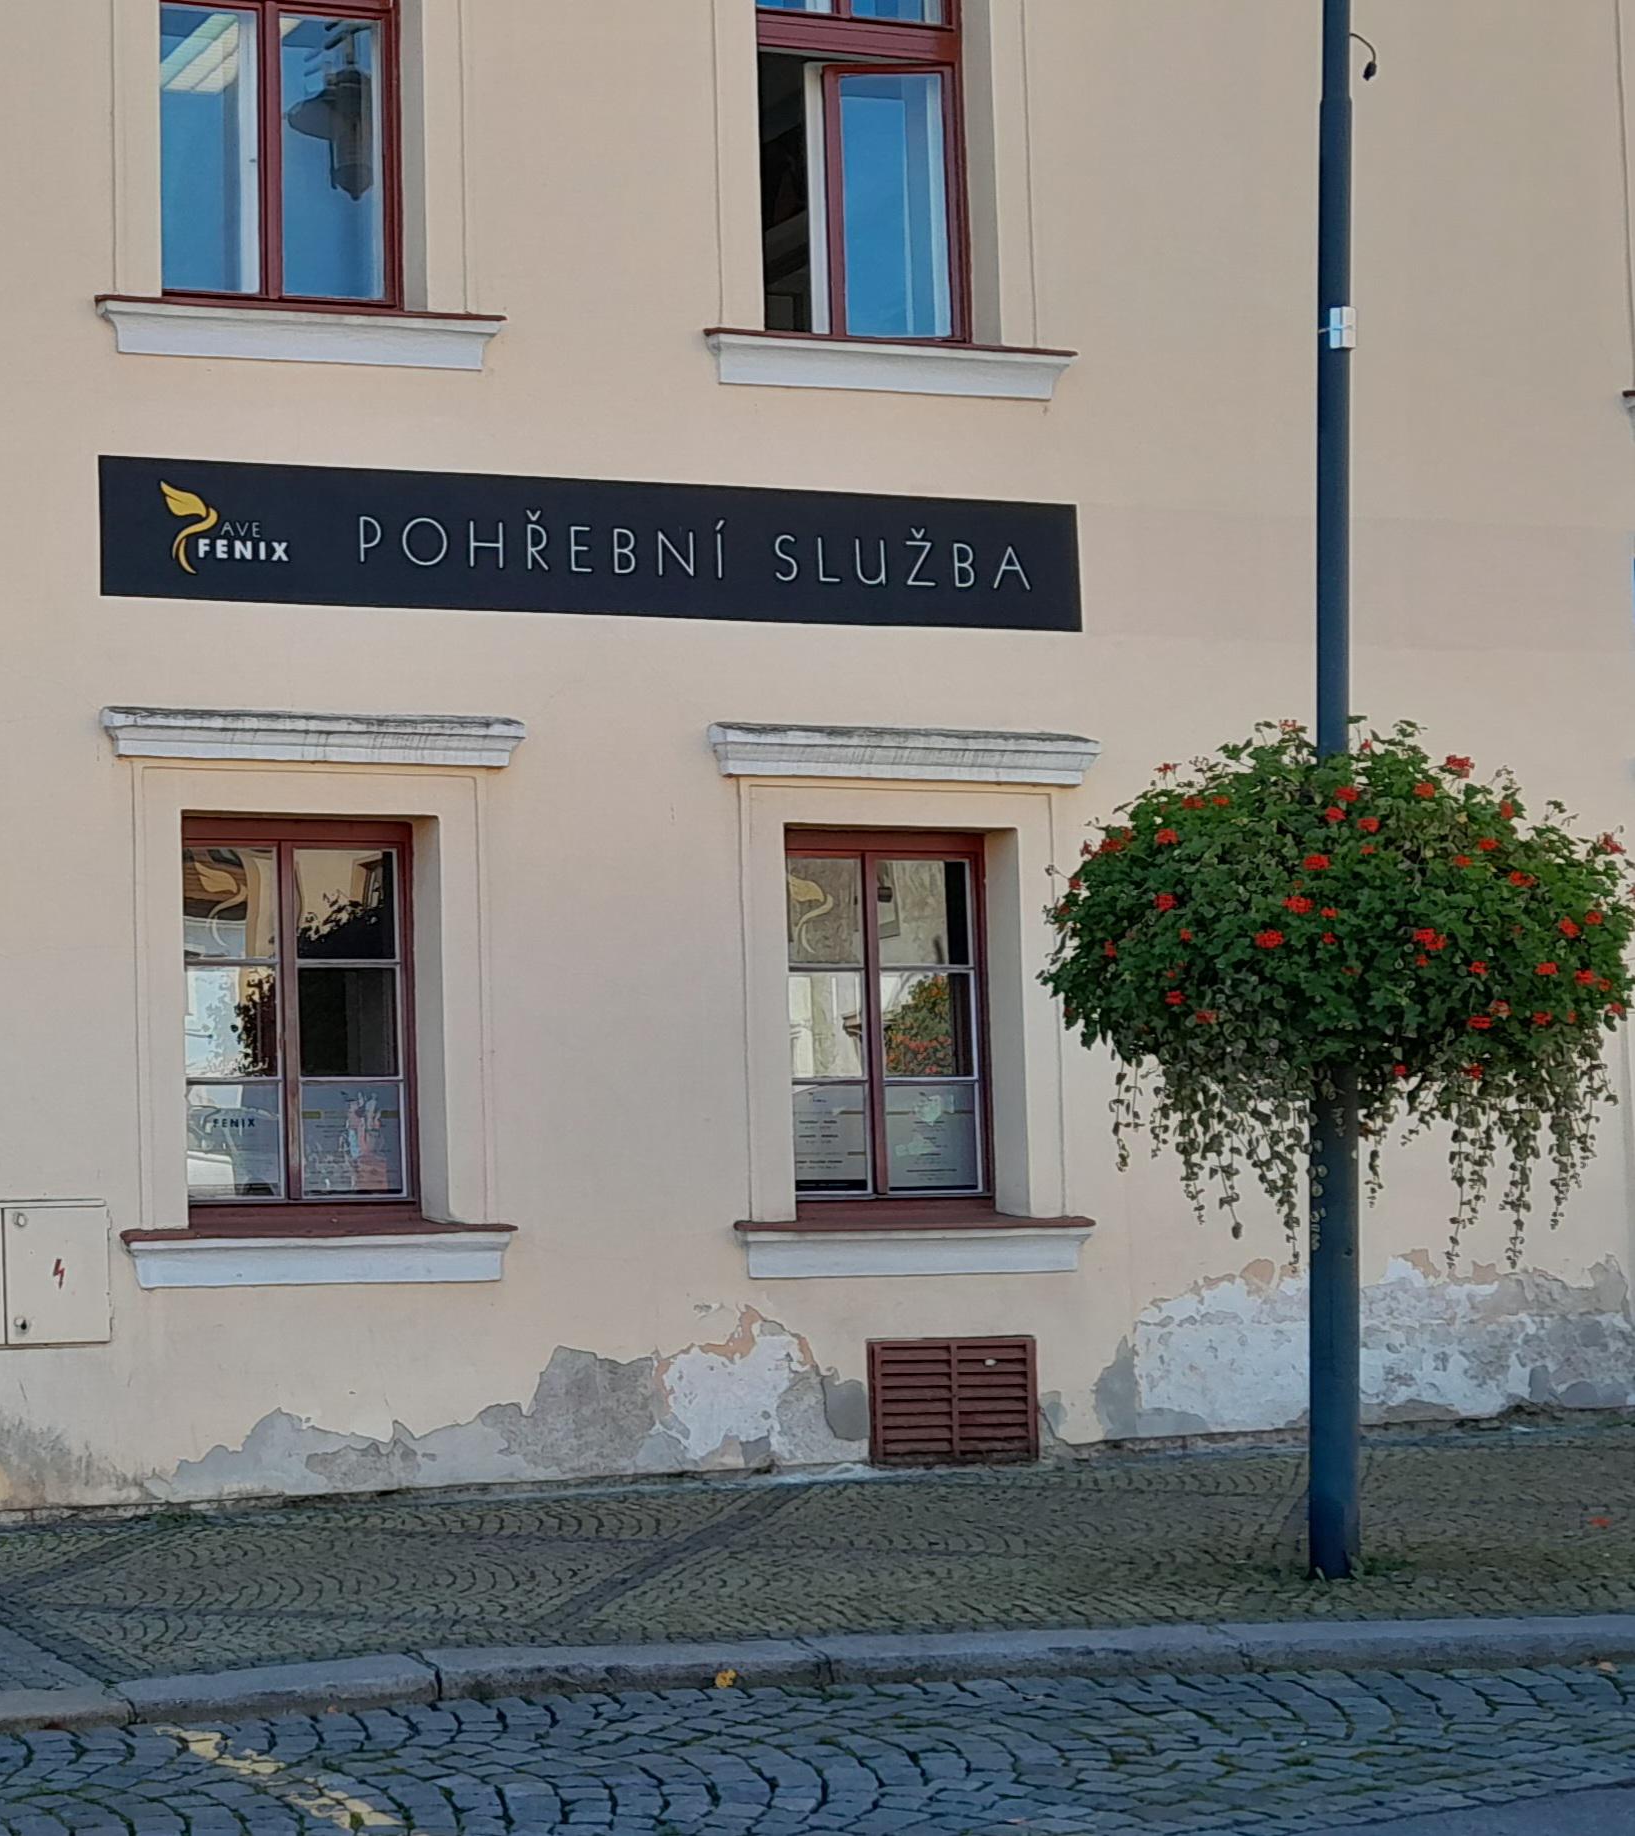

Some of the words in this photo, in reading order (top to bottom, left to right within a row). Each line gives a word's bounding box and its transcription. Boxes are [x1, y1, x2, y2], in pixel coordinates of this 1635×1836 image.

[220, 521, 261, 538] AVE
[197, 538, 290, 562] FENIX
[358, 509, 726, 579] POHŘEBNÍ
[774, 527, 1032, 591] SLUŽBA
[212, 1118, 256, 1129] FENIX
